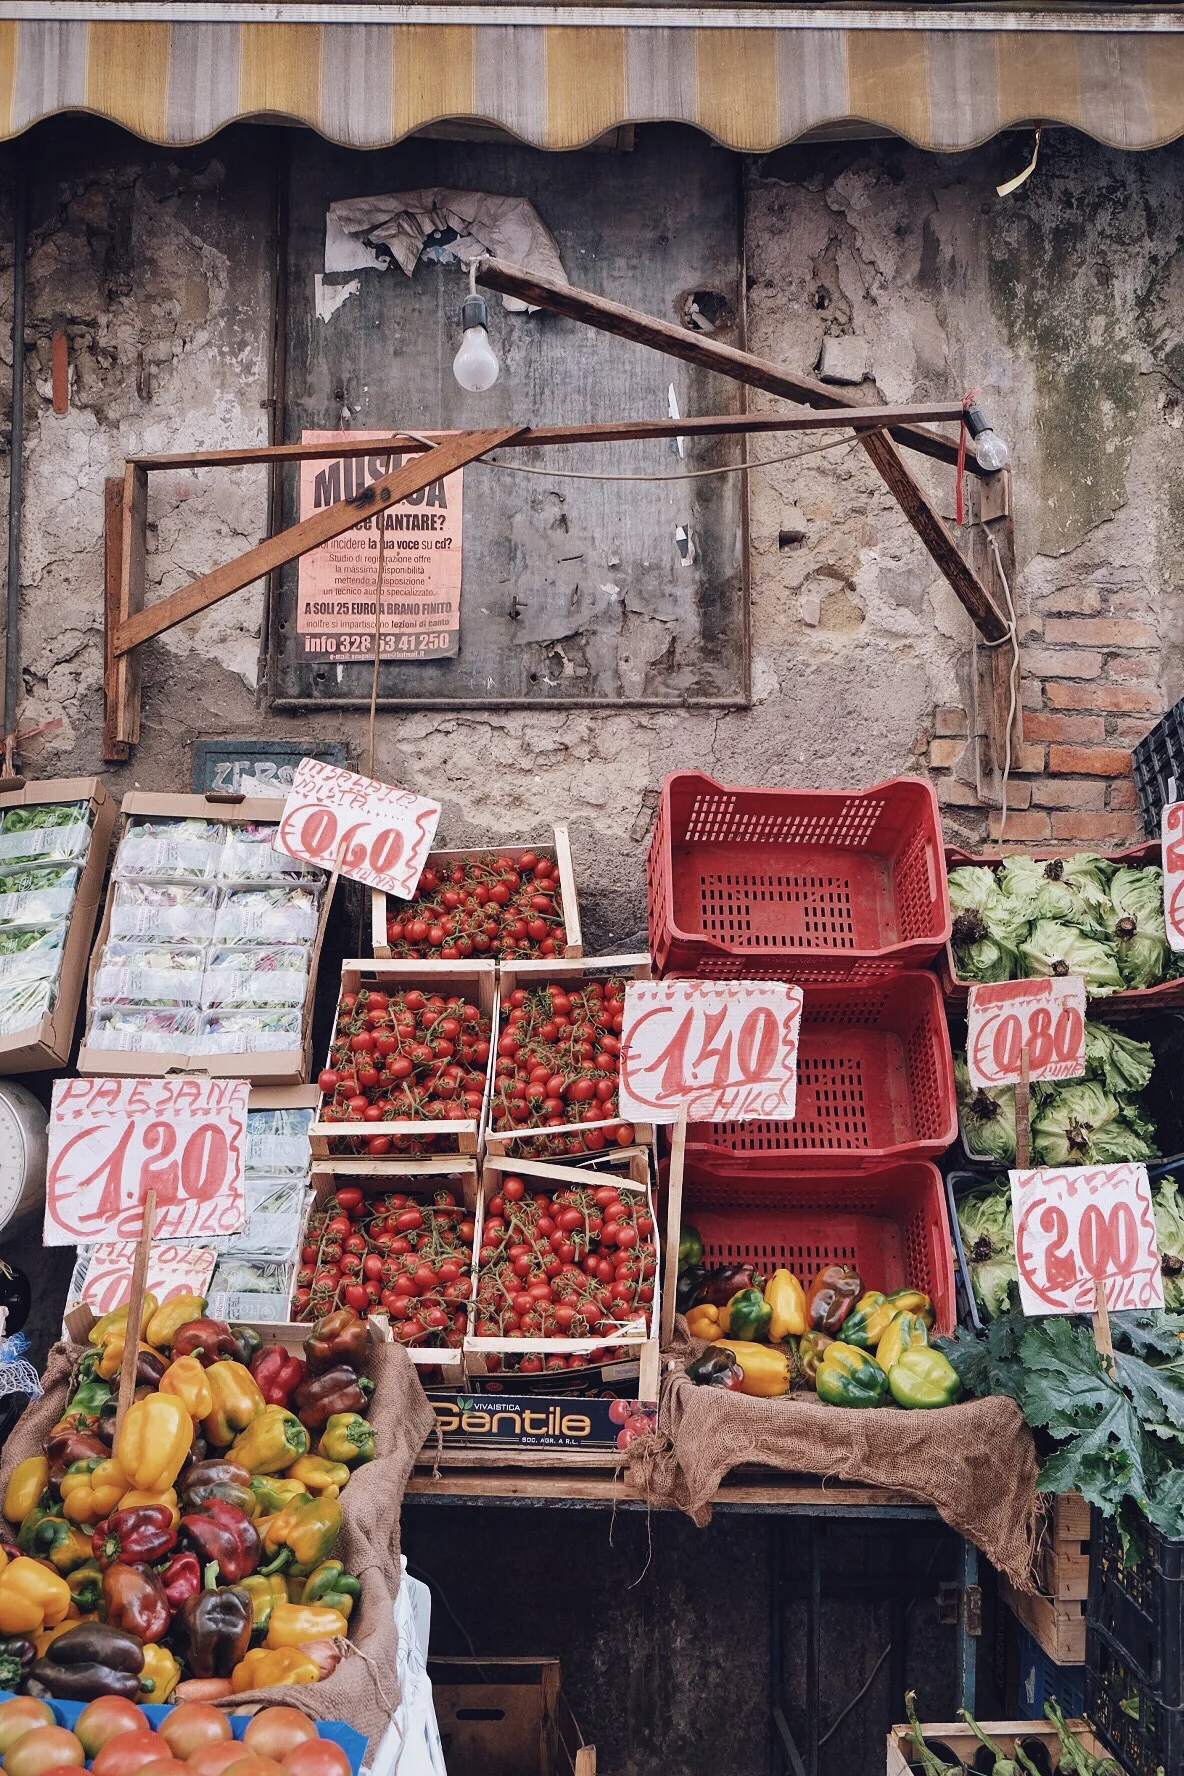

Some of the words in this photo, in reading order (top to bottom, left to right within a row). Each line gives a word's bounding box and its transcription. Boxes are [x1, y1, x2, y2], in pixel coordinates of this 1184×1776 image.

[331, 538, 366, 550] incidere
[368, 537, 377, 550] la
[378, 539, 395, 550] ua
[397, 540, 420, 550] voce
[421, 541, 433, 550] su
[435, 537, 453, 550] cd?
[329, 553, 354, 563] Studio
[355, 553, 364, 563] di
[414, 554, 432, 563] offre
[335, 565, 341, 573] la
[334, 576, 370, 585] mettendo
[323, 588, 333, 596] un
[336, 587, 362, 596] tecnico
[363, 587, 385, 596] audo
[304, 602, 312, 615] A
[313, 602, 335, 615] SOLI
[336, 602, 350, 615] 25
[351, 602, 376, 615] EURO
[387, 602, 419, 616] BRANO
[422, 601, 453, 615] FINITO
[306, 619, 330, 629] inoltre
[331, 620, 339, 628] si
[340, 620, 390, 630] impartiscno
[391, 619, 417, 629] lezioni
[419, 618, 427, 628] di
[428, 617, 450, 628] canto
[305, 635, 337, 652] info
[340, 635, 371, 652] 328
[398, 635, 415, 651] 41
[418, 632, 450, 650] 250
[300, 758, 419, 805] INSALATA
[295, 779, 368, 810] MISTA
[473, 1402, 521, 1412] VIVAISTICA
[430, 1401, 592, 1437] Gentile
